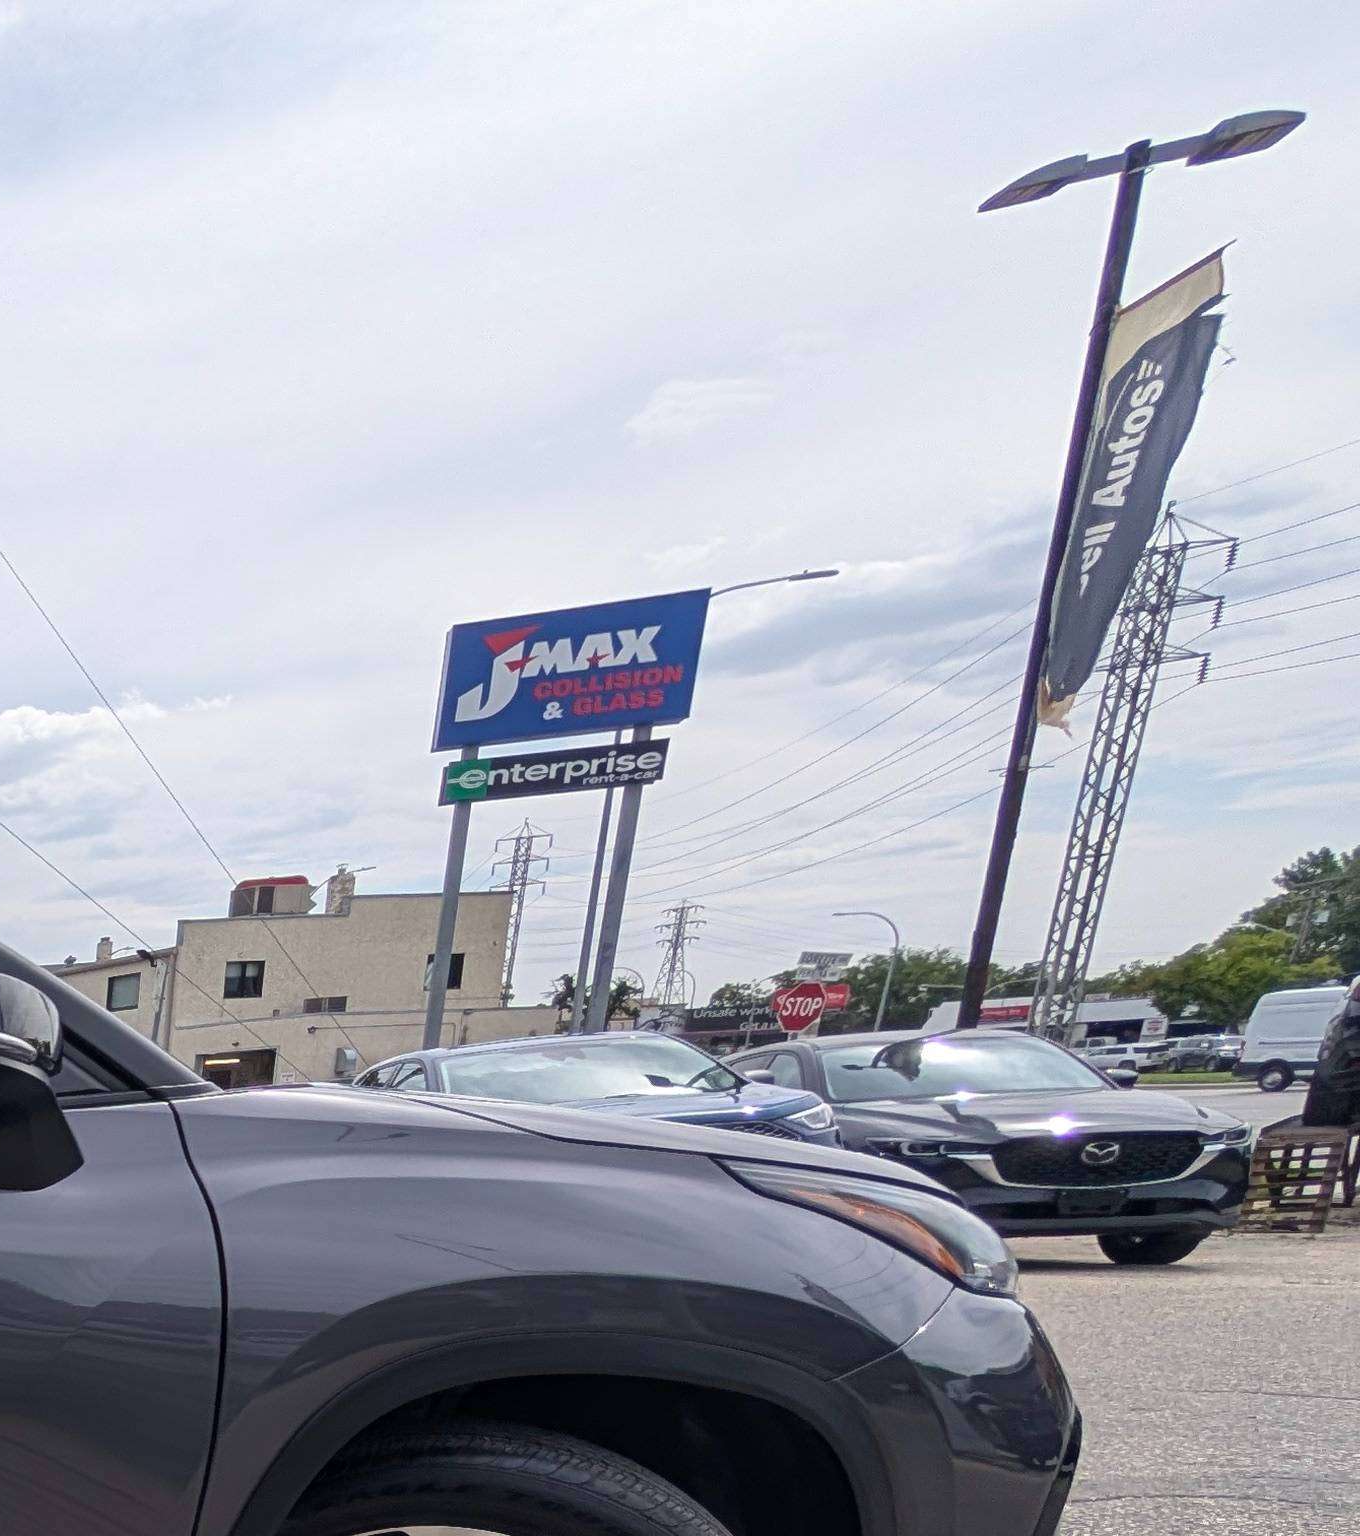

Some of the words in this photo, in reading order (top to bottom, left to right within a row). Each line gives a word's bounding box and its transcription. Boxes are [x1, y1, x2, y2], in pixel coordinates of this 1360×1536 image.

[1092, 379, 1164, 506] Autos
[533, 664, 684, 699] COLLISION
[542, 701, 564, 720] &
[571, 688, 665, 716] GLASS
[448, 750, 663, 789] enterprise
[582, 770, 659, 785] rent-a-car
[781, 996, 823, 1017] STOP
